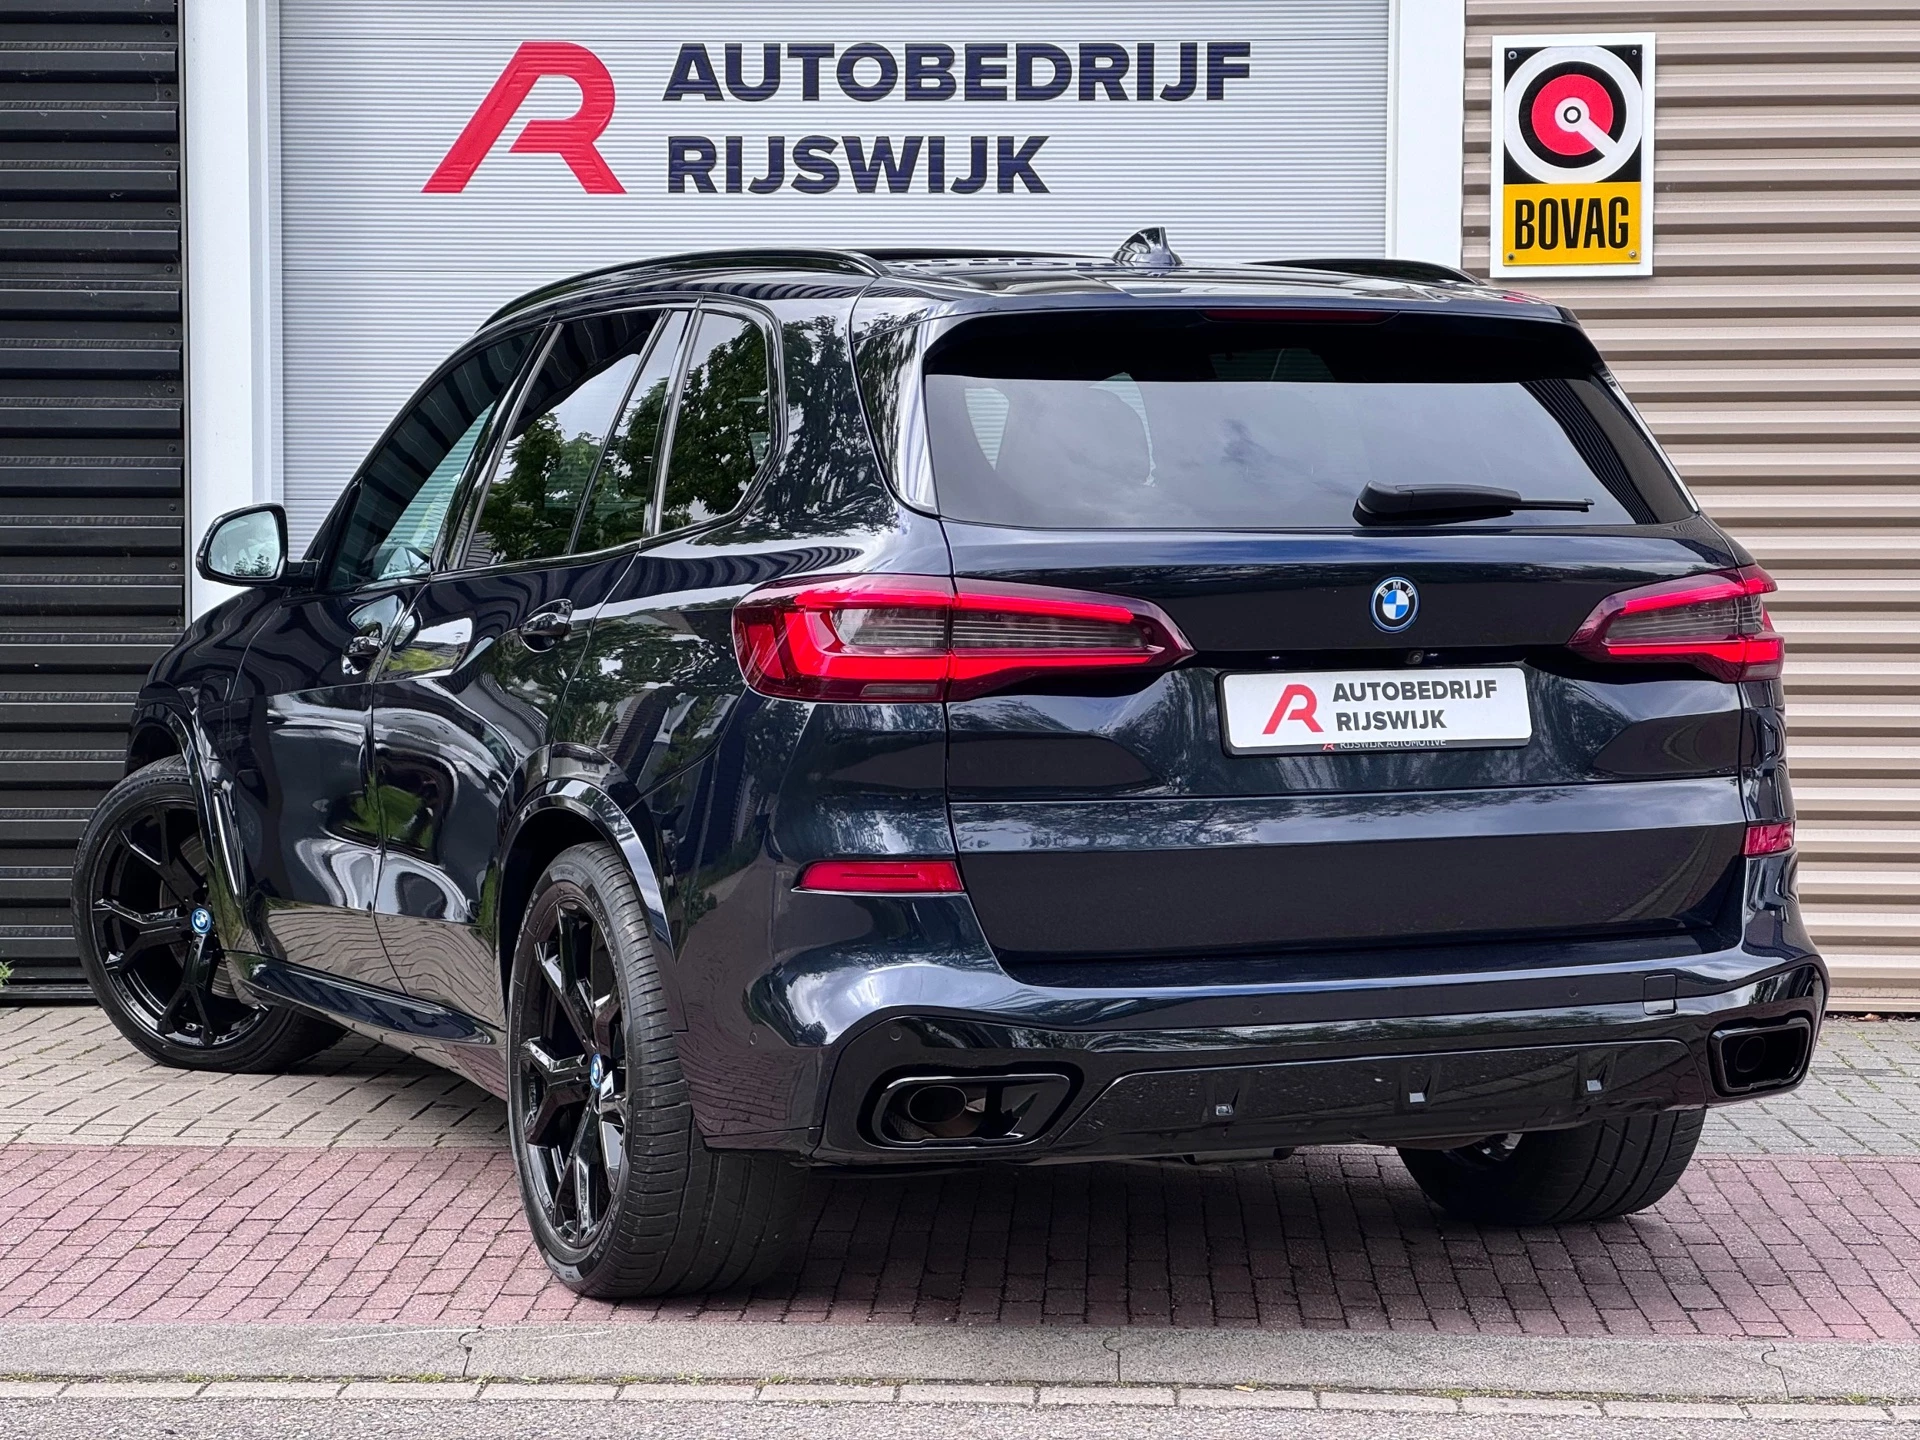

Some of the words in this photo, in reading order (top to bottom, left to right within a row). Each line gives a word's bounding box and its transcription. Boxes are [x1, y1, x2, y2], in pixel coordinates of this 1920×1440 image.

[662, 42, 1252, 102] AUTOBEDRIJF
[667, 135, 1051, 194] RIJSWIJK
[1514, 196, 1629, 250] BOVAG
[1379, 581, 1414, 598] BMW
[1332, 679, 1498, 702] AUTOBEDRIJF
[1335, 709, 1447, 732] RIJSWIJK
[1386, 739, 1447, 748] AUTOMOTIVE
